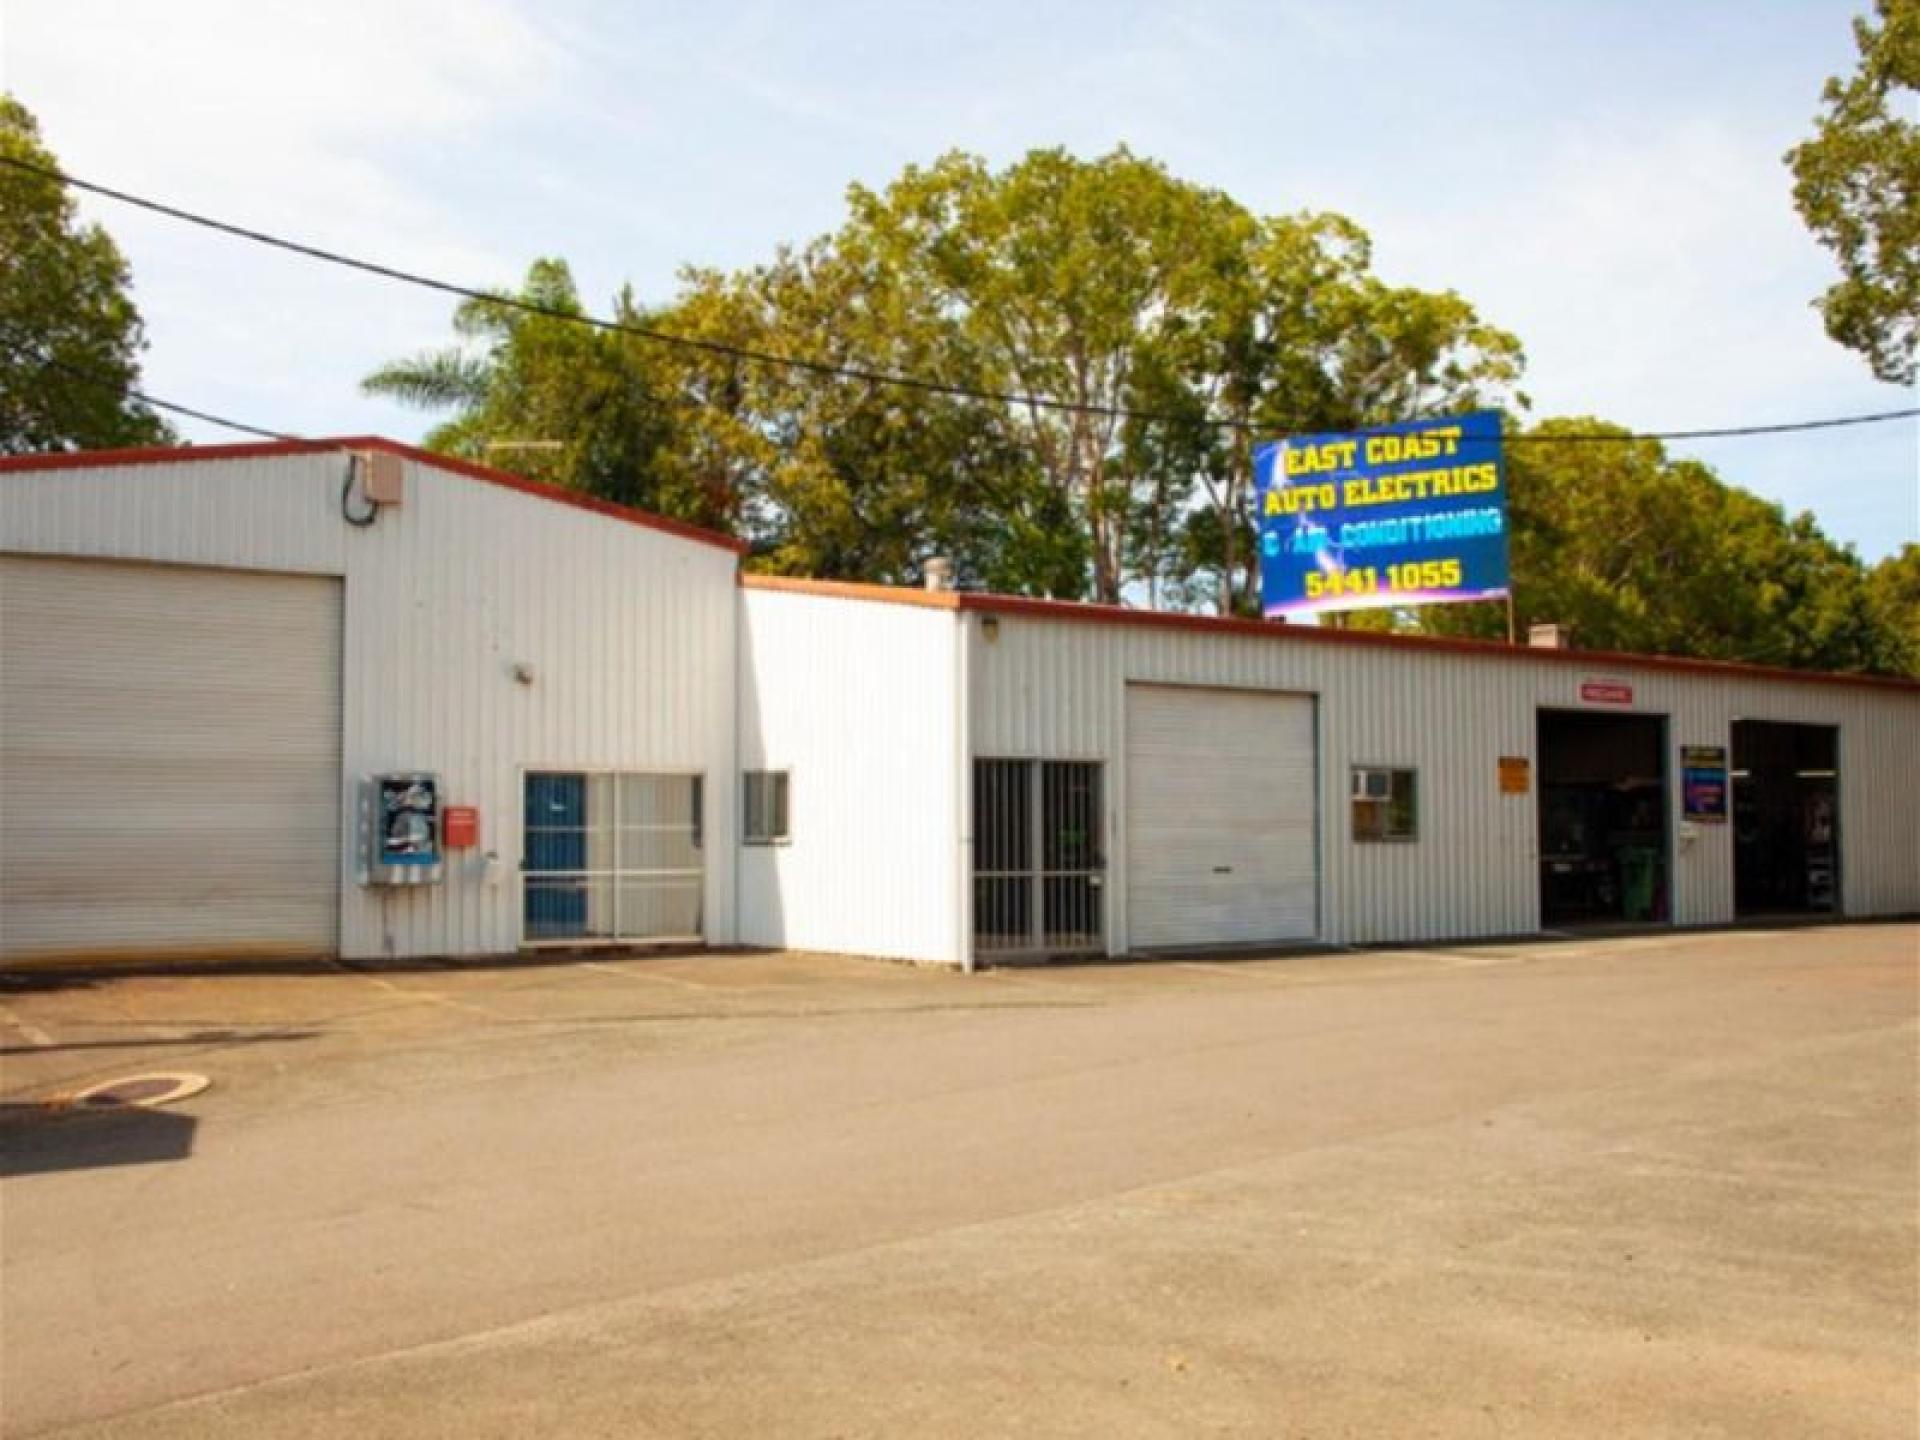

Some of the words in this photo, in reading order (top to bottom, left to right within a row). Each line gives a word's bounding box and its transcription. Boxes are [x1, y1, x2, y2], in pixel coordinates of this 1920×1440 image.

[1285, 440, 1357, 475] EAST
[1365, 426, 1462, 465] COAST
[1264, 484, 1336, 516] AUTO
[1343, 463, 1498, 507] ELECTRICS
[1340, 508, 1502, 549] CONDITIONING
[1305, 567, 1378, 599] 5441
[1385, 559, 1460, 591] 1055
